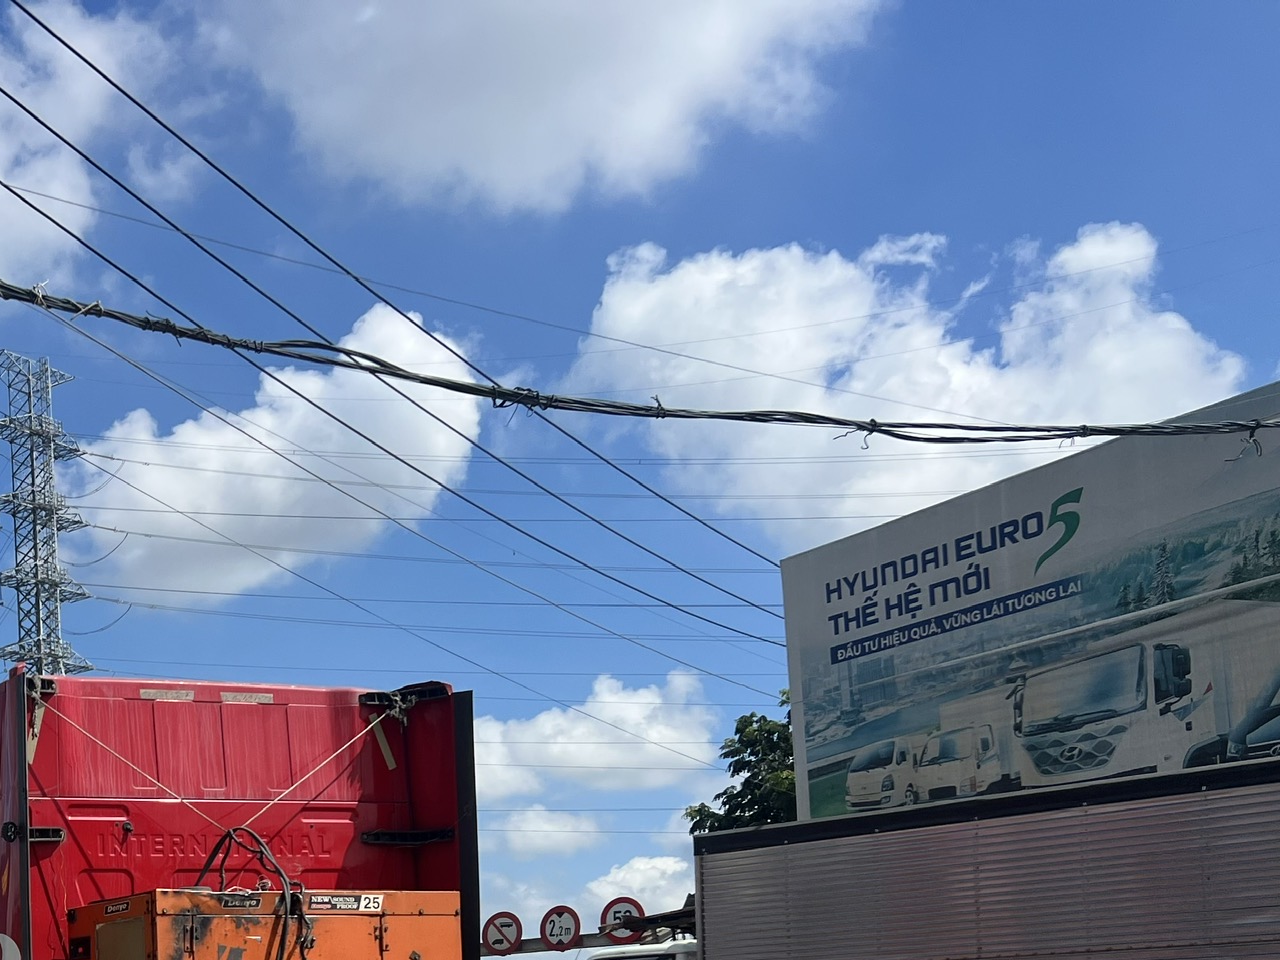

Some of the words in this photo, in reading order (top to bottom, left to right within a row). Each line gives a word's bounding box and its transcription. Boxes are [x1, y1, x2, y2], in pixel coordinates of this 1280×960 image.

[825, 542, 949, 603] HYUNDAI
[828, 590, 880, 636] THẾ
[885, 582, 923, 620] HỆ
[929, 562, 991, 607] MỚI
[837, 642, 861, 660] ĐẦU
[863, 637, 879, 653] TƯ
[881, 630, 908, 649] HIỆU
[910, 618, 941, 640] QUẢ,
[942, 610, 980, 630] VỮNG
[983, 602, 1004, 619] LÁI
[1006, 587, 1056, 612] TƯƠNG
[1060, 580, 1081, 597] LAI
[310, 895, 330, 903] NEW
[363, 896, 380, 910] 25
